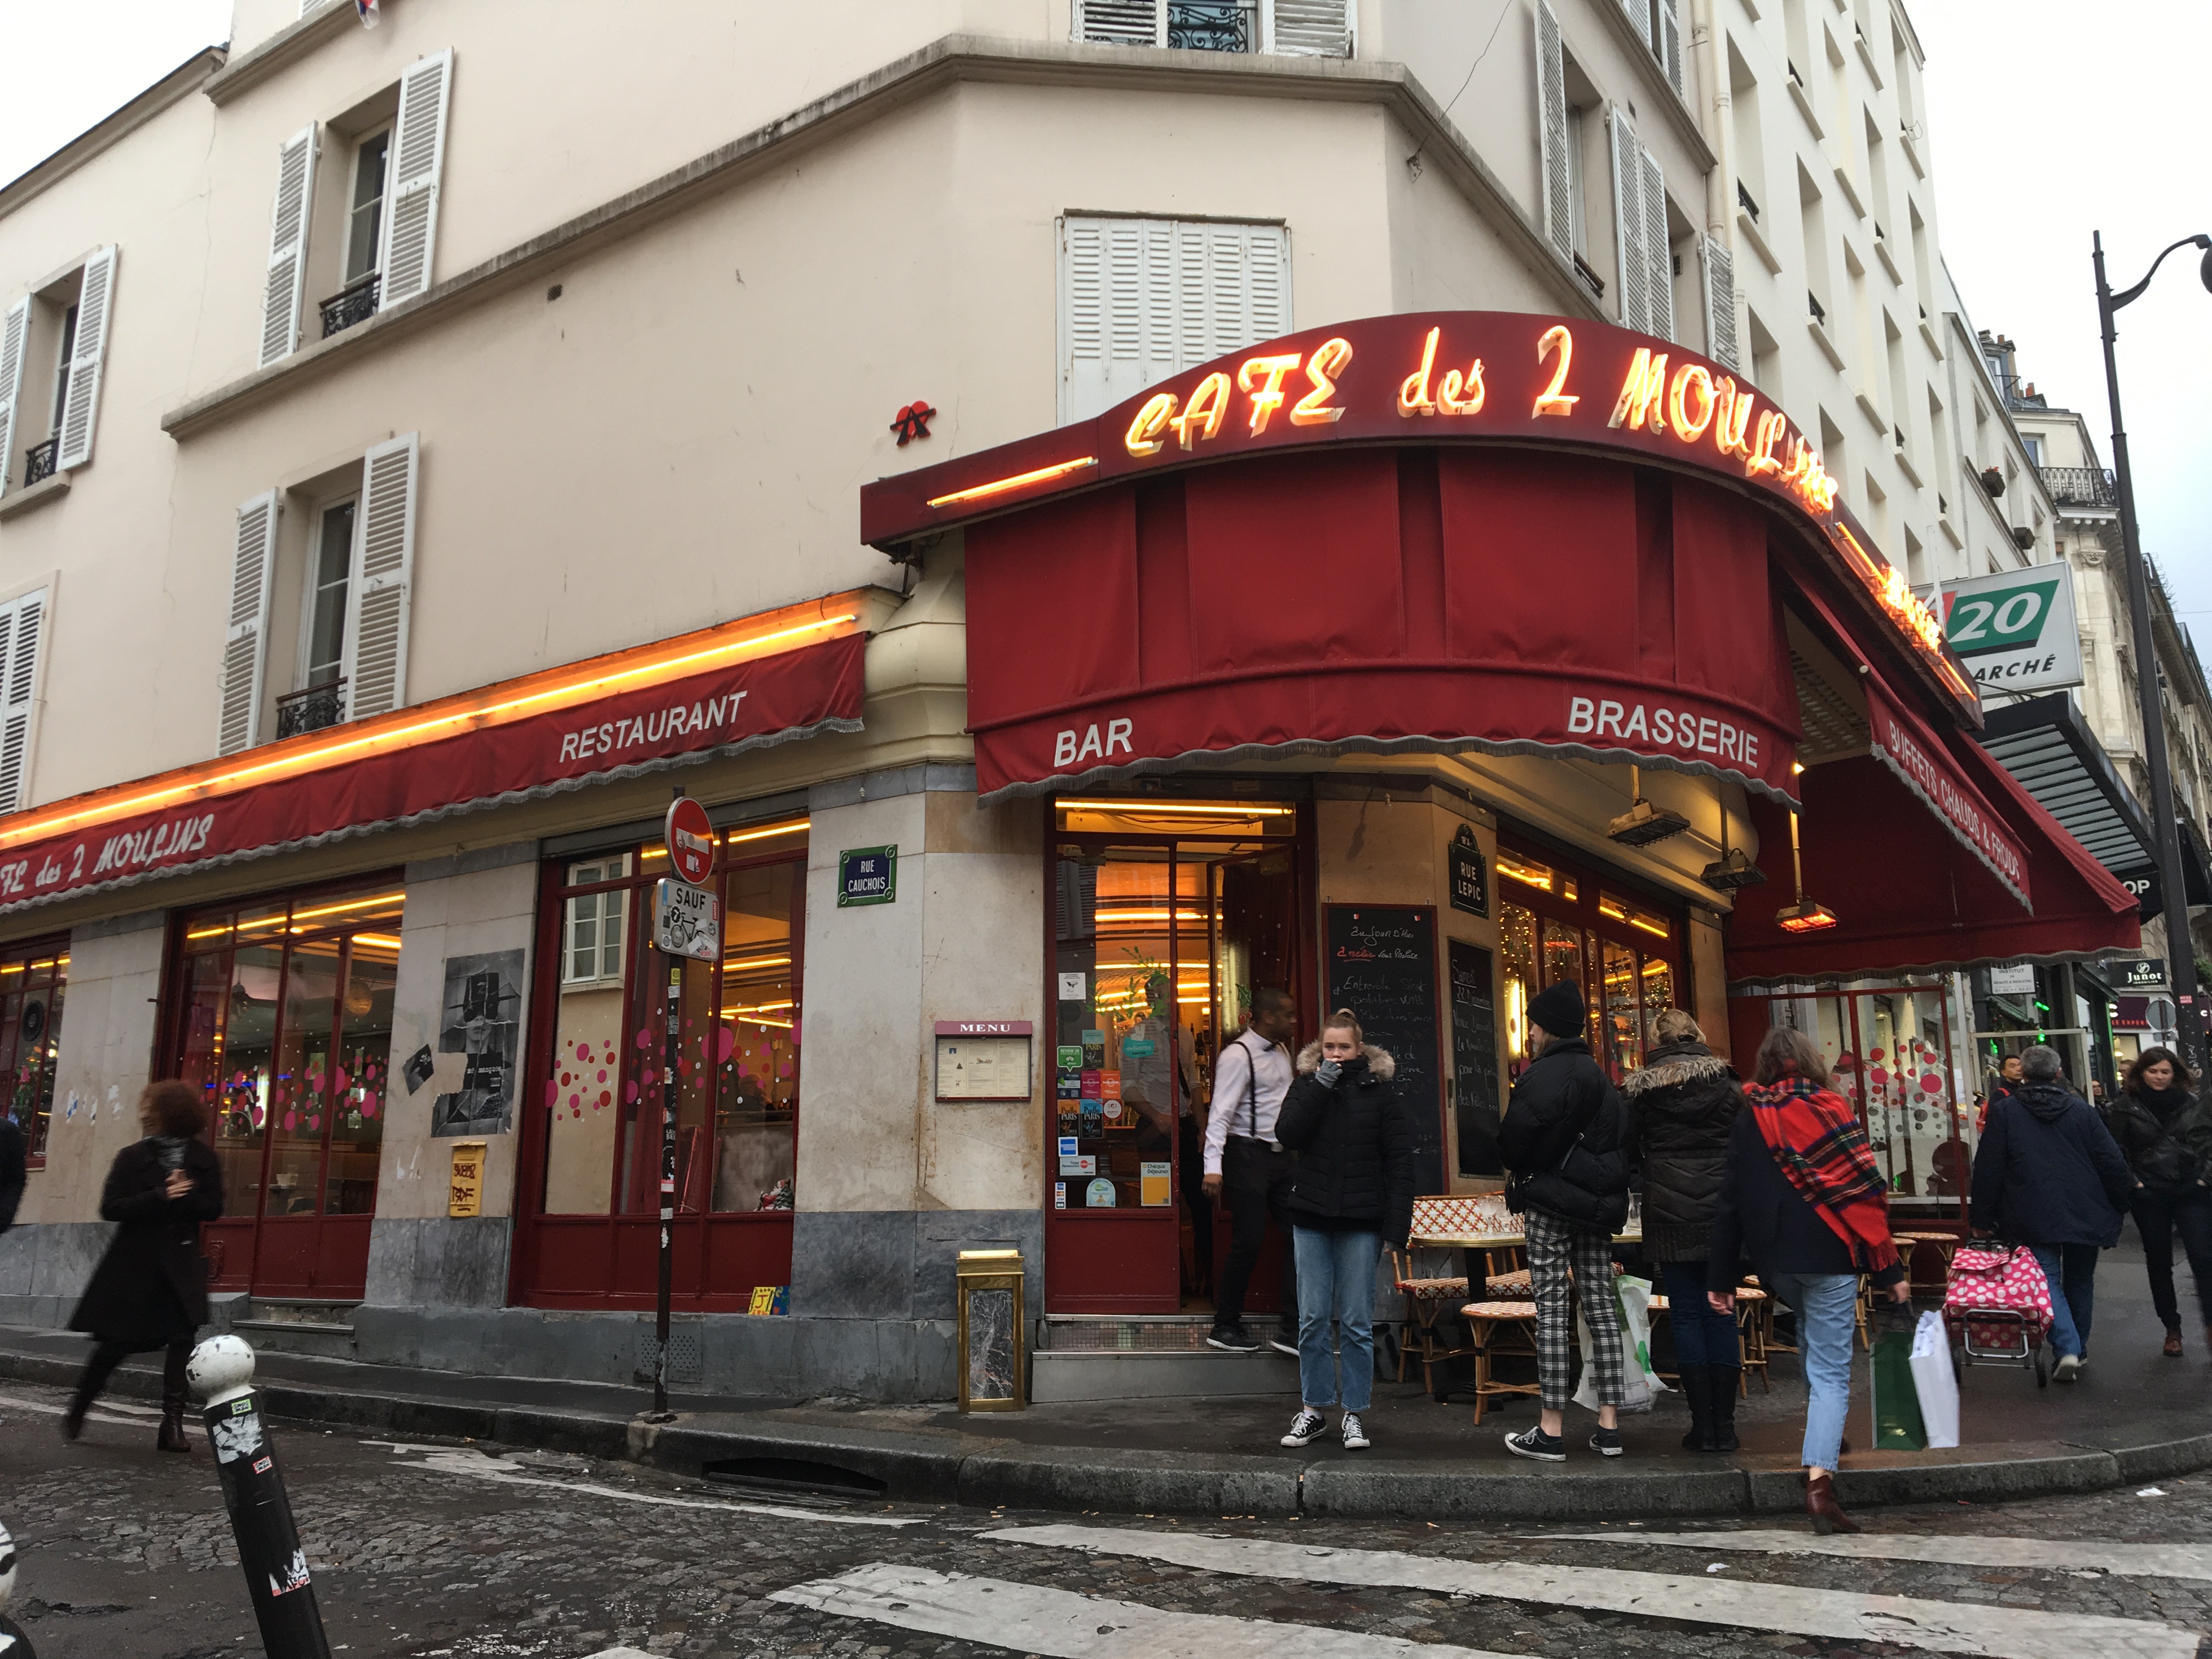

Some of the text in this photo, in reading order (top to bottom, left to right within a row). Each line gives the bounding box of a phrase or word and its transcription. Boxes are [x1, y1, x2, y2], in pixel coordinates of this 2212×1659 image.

[1125, 337, 1353, 458] CAFE
[1397, 326, 1485, 417] des
[1532, 325, 1580, 419] 2
[1976, 654, 2056, 681] ARCHÉ
[558, 690, 748, 763] RESTAURANT
[1567, 697, 1759, 769] BRASSERIE
[1053, 718, 1133, 768] BAR
[1889, 719, 2021, 881] BUFFETS CHAUDS & FROIDS
[0, 813, 215, 897] FE des 2 MOULINS
[860, 860, 875, 873] RUE
[1460, 861, 1477, 881] RUE
[848, 876, 885, 892] CAUCHOIS
[1458, 879, 1481, 901] LEPIC
[675, 887, 706, 910] SAUF
[2127, 972, 2162, 983] Junot
[960, 1024, 1011, 1032] MENU
[1084, 1105, 1101, 1114] Pudlo
